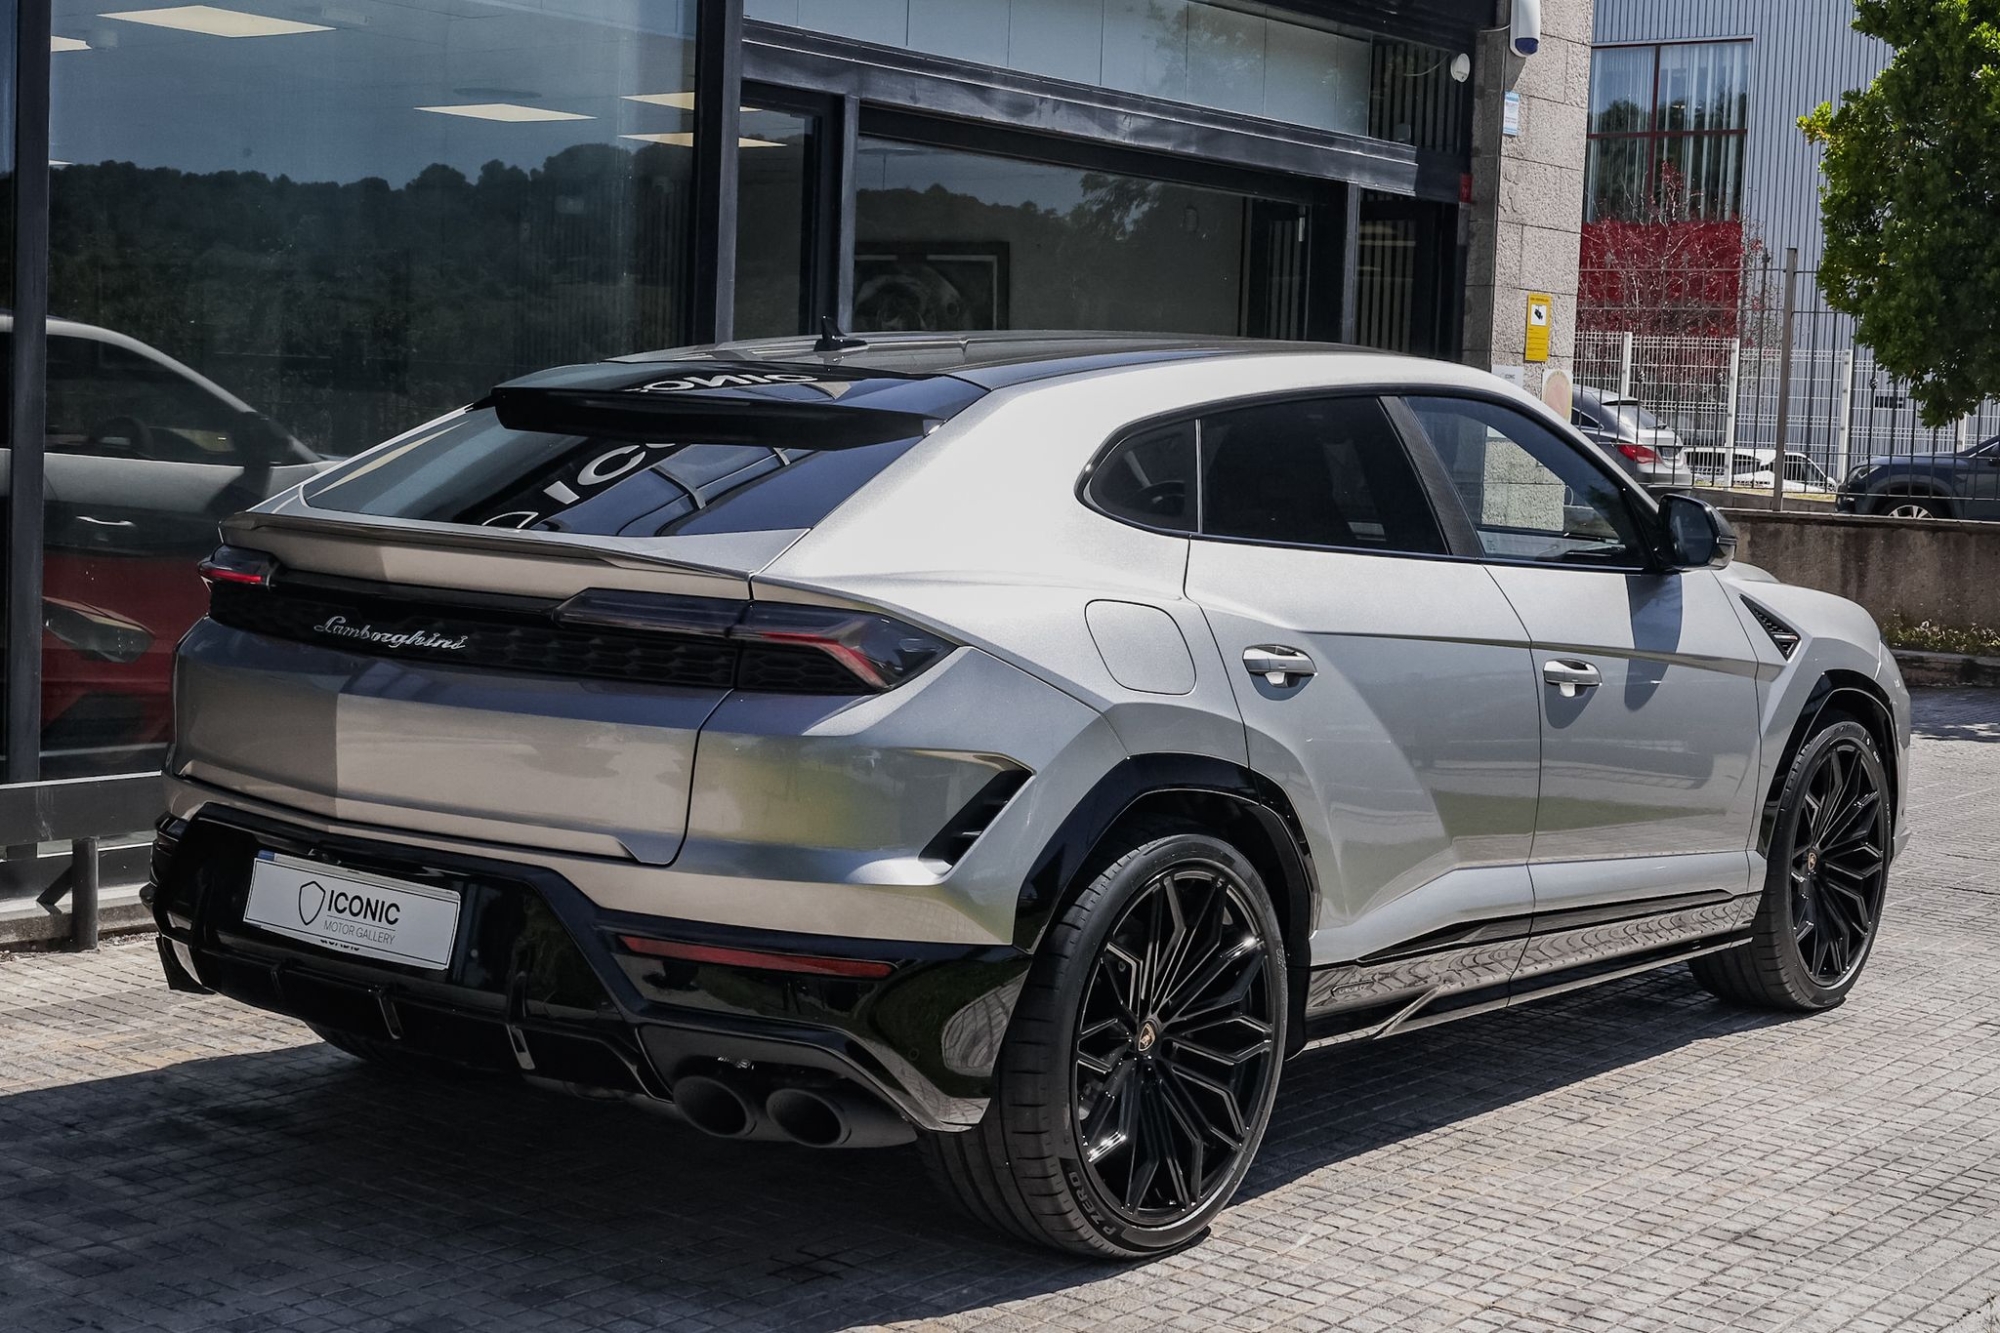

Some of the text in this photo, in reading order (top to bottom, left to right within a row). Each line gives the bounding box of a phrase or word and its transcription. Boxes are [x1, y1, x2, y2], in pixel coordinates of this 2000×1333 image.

[313, 615, 469, 650] Lamborghini
[327, 889, 401, 925] ICONIC
[323, 919, 355, 935] MOTOR
[356, 926, 396, 945] GALLERY
[1068, 1171, 1106, 1225] ZERO
